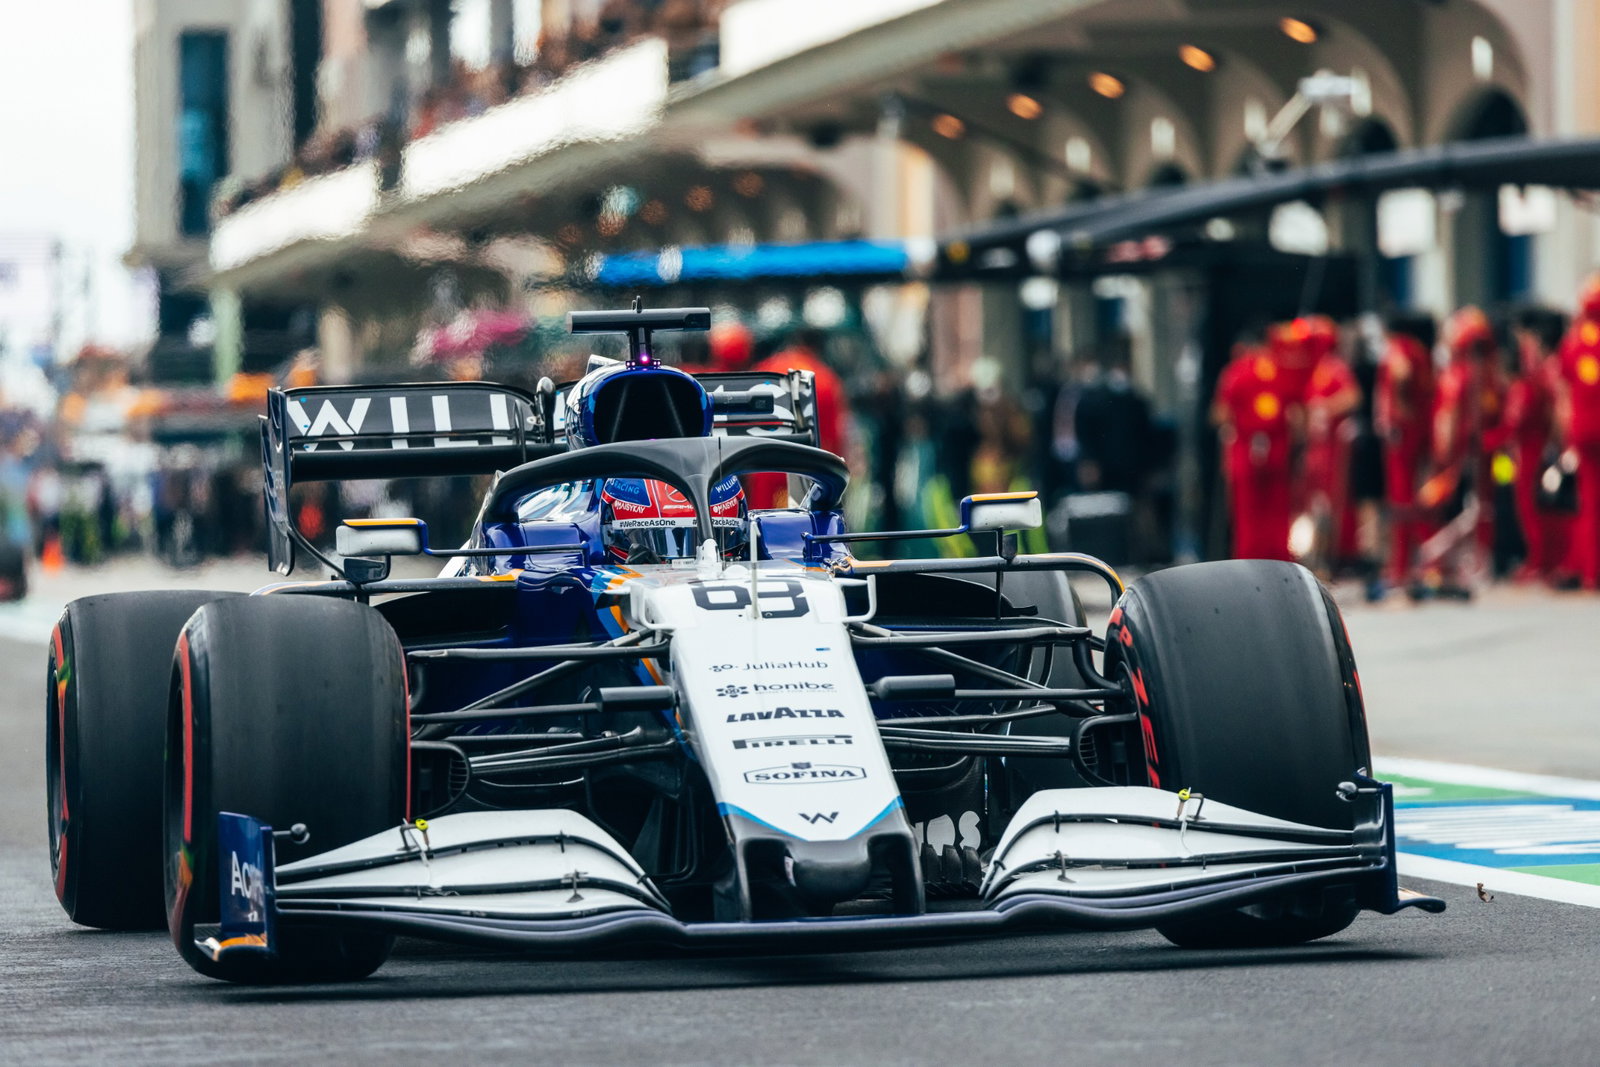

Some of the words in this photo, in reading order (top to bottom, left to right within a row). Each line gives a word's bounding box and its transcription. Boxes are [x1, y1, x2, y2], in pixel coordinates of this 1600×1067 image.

[614, 480, 640, 494] RACING
[620, 520, 676, 528] #WeRaceAsOne
[689, 579, 810, 619] 63
[742, 660, 829, 671] JuliaHub
[753, 681, 836, 692] honibe
[726, 706, 846, 723] LAVAZZA
[732, 734, 853, 750] PIRELLI
[754, 769, 858, 781] SOFINA
